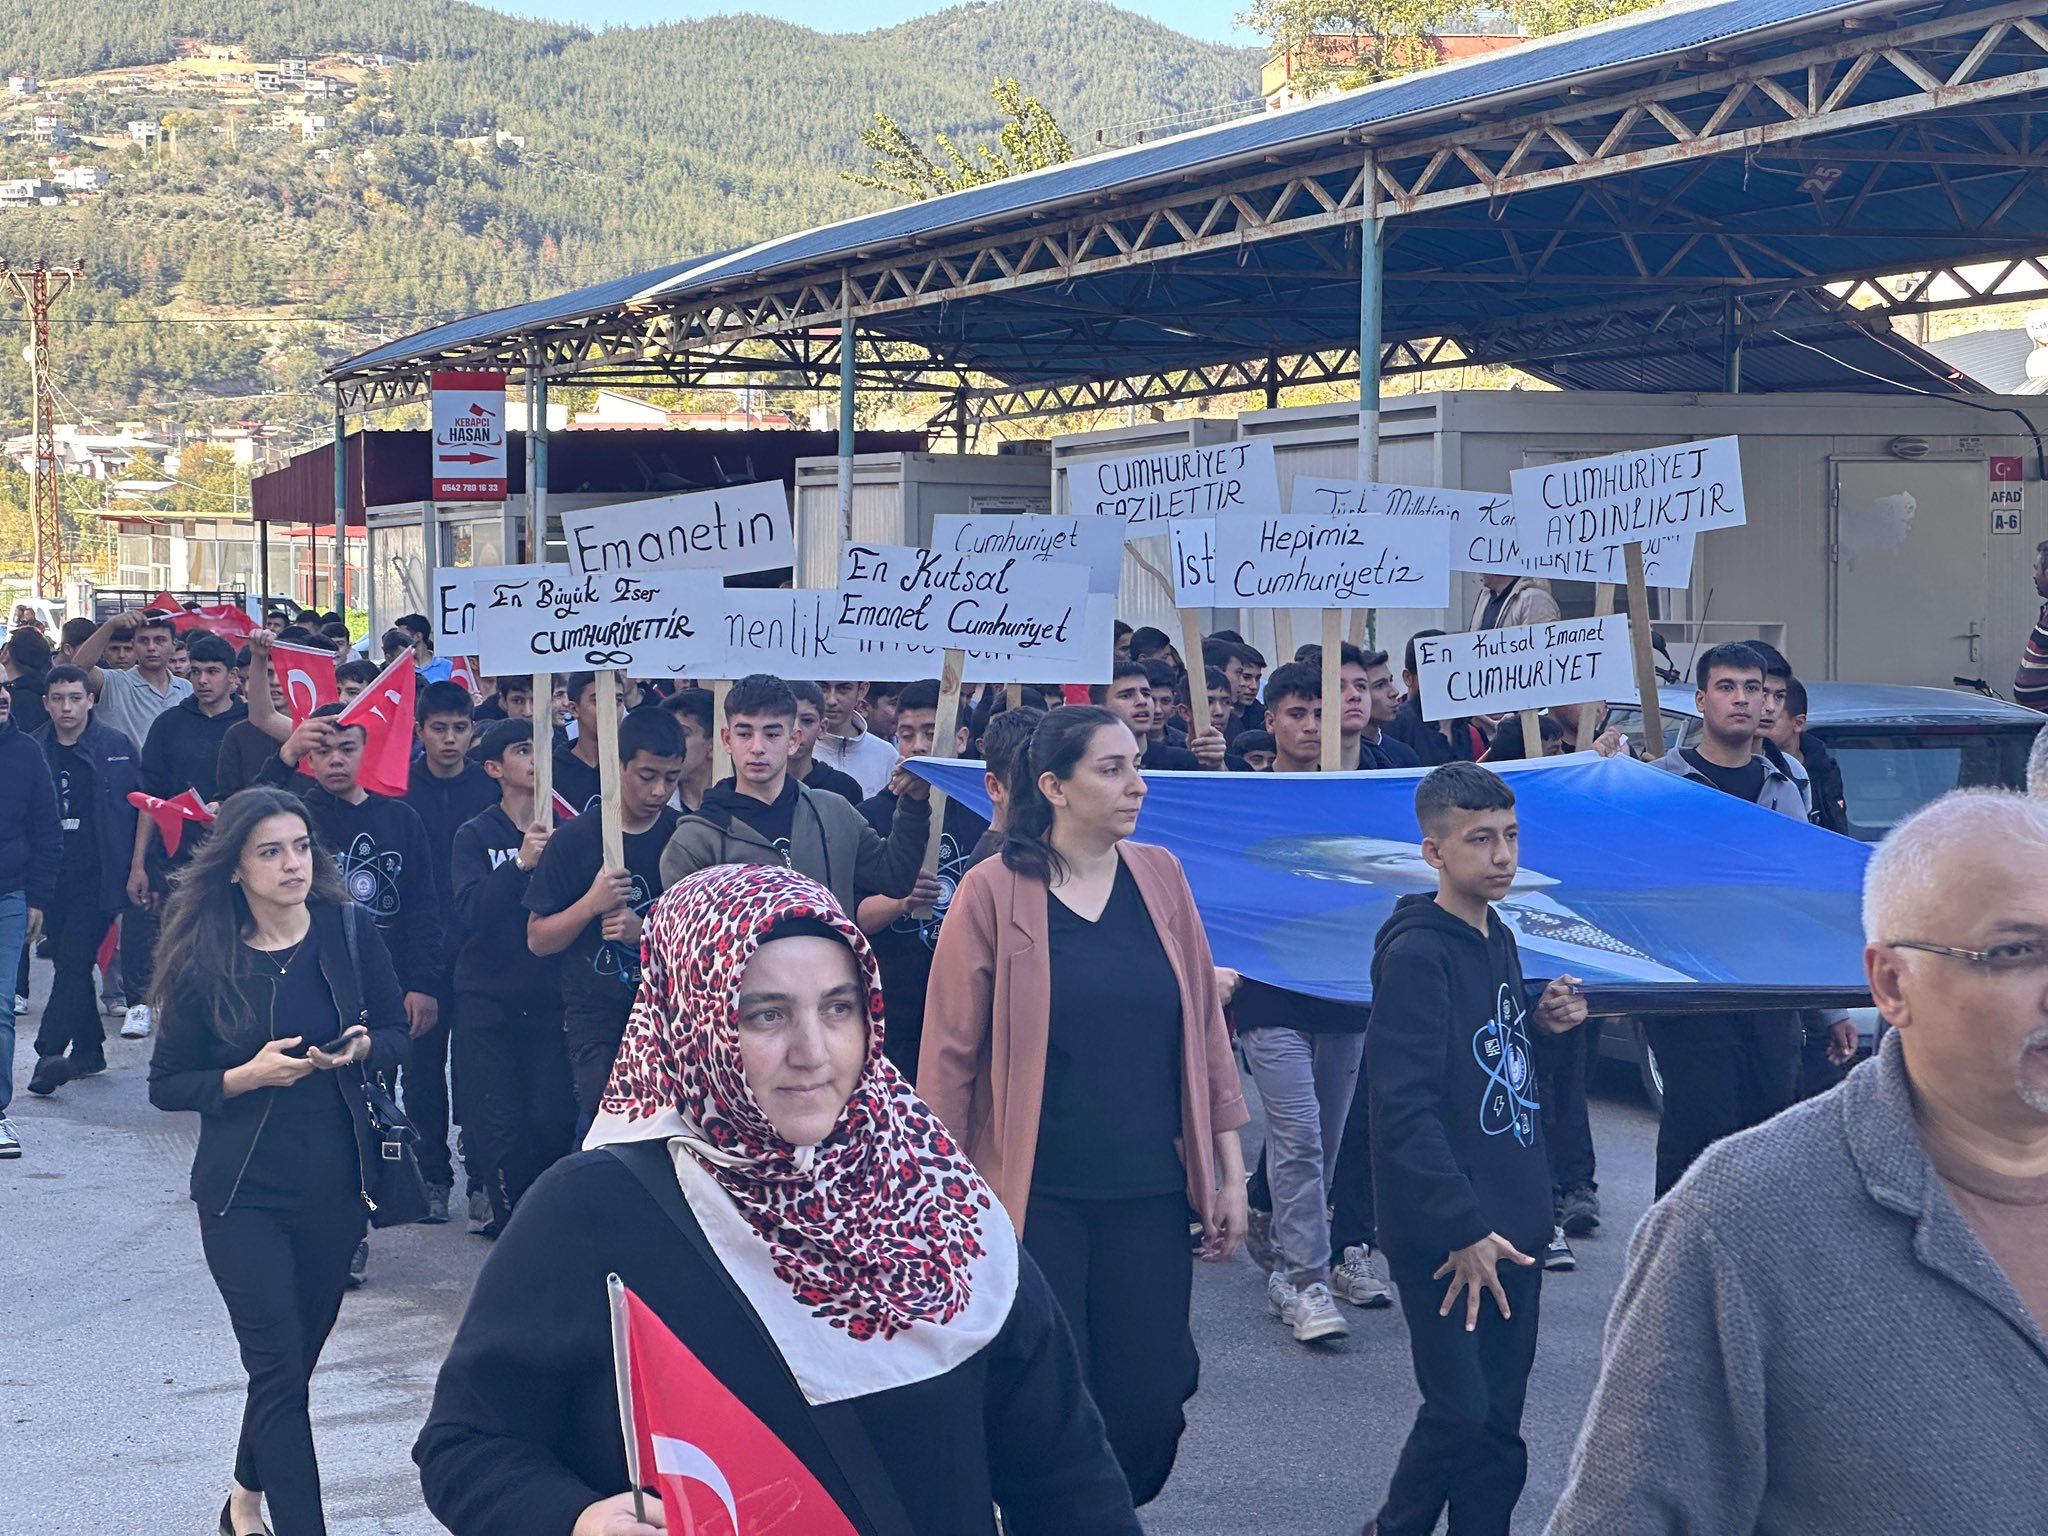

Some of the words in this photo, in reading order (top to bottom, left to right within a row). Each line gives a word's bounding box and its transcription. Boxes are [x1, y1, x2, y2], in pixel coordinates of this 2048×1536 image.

[449, 428, 490, 442] HASAN
[455, 418, 490, 427] KEBAPCI
[442, 484, 461, 492] 0542
[1991, 491, 2021, 503] AFAD
[574, 501, 774, 573] Emanetin
[1547, 482, 1735, 547] AYDINLIKTIR
[1995, 515, 2018, 529] A-6
[955, 520, 1078, 561] Cumhuriyet
[1260, 521, 1365, 558] Hepimiz
[849, 547, 888, 582] En
[900, 549, 1016, 594] Kutsal
[1234, 548, 1424, 599] Cumhuriyetiz
[488, 581, 529, 608] En
[536, 575, 599, 619] Büyük
[610, 577, 660, 603] Eser
[531, 608, 695, 655] CUMHURİYETTİR
[838, 593, 932, 630] Emanet
[948, 600, 1072, 647] Cumhuriyet
[1419, 642, 1452, 665] En
[1472, 626, 1535, 659] Kutsal
[1544, 619, 1604, 650] Emanet
[1447, 652, 1602, 701] CUMHURİYET
